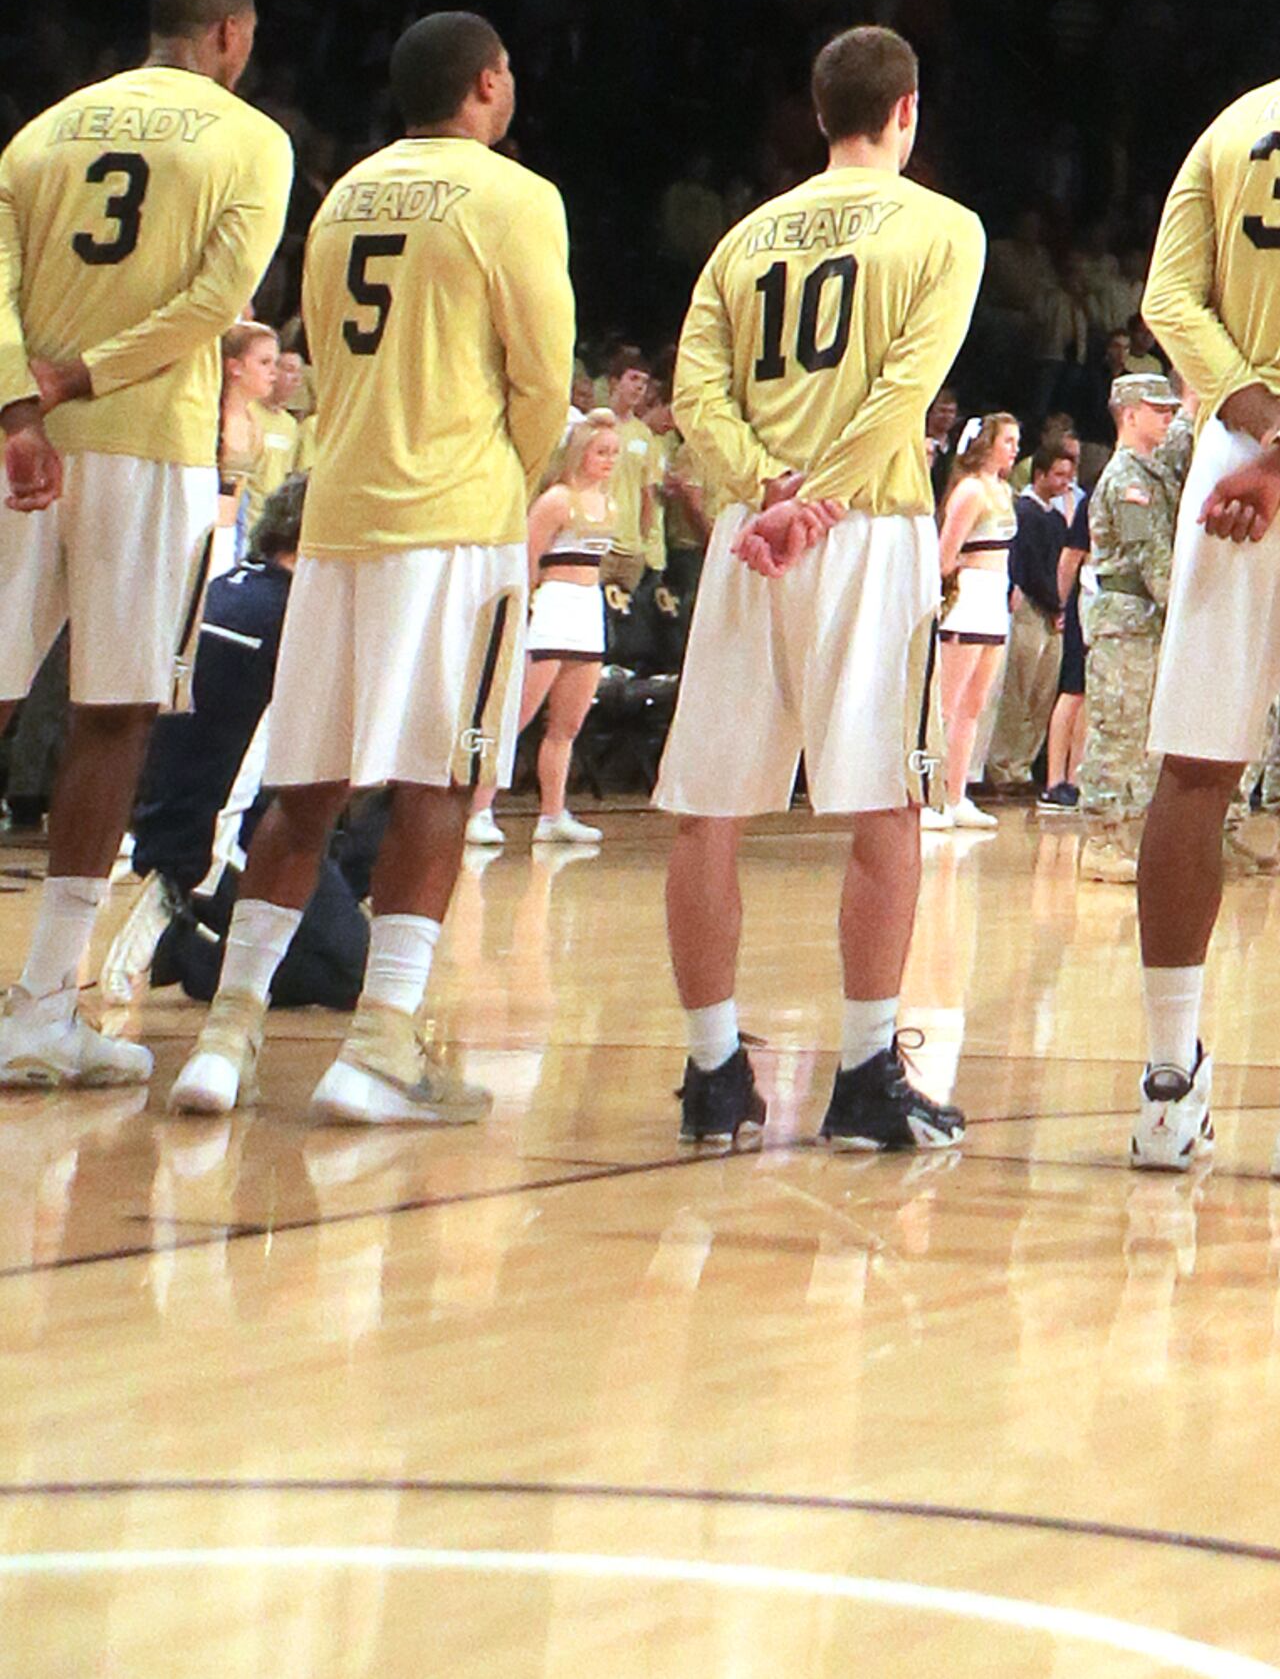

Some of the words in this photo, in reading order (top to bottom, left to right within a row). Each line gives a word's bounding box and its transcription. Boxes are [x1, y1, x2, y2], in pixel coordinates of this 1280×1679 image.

[52, 106, 220, 144] READY
[71, 153, 150, 265] 3
[324, 180, 471, 225] READY
[744, 200, 905, 259] READY
[341, 234, 407, 355] 5
[754, 254, 859, 382] 10
[460, 727, 496, 759] GT
[908, 749, 941, 780] GT
